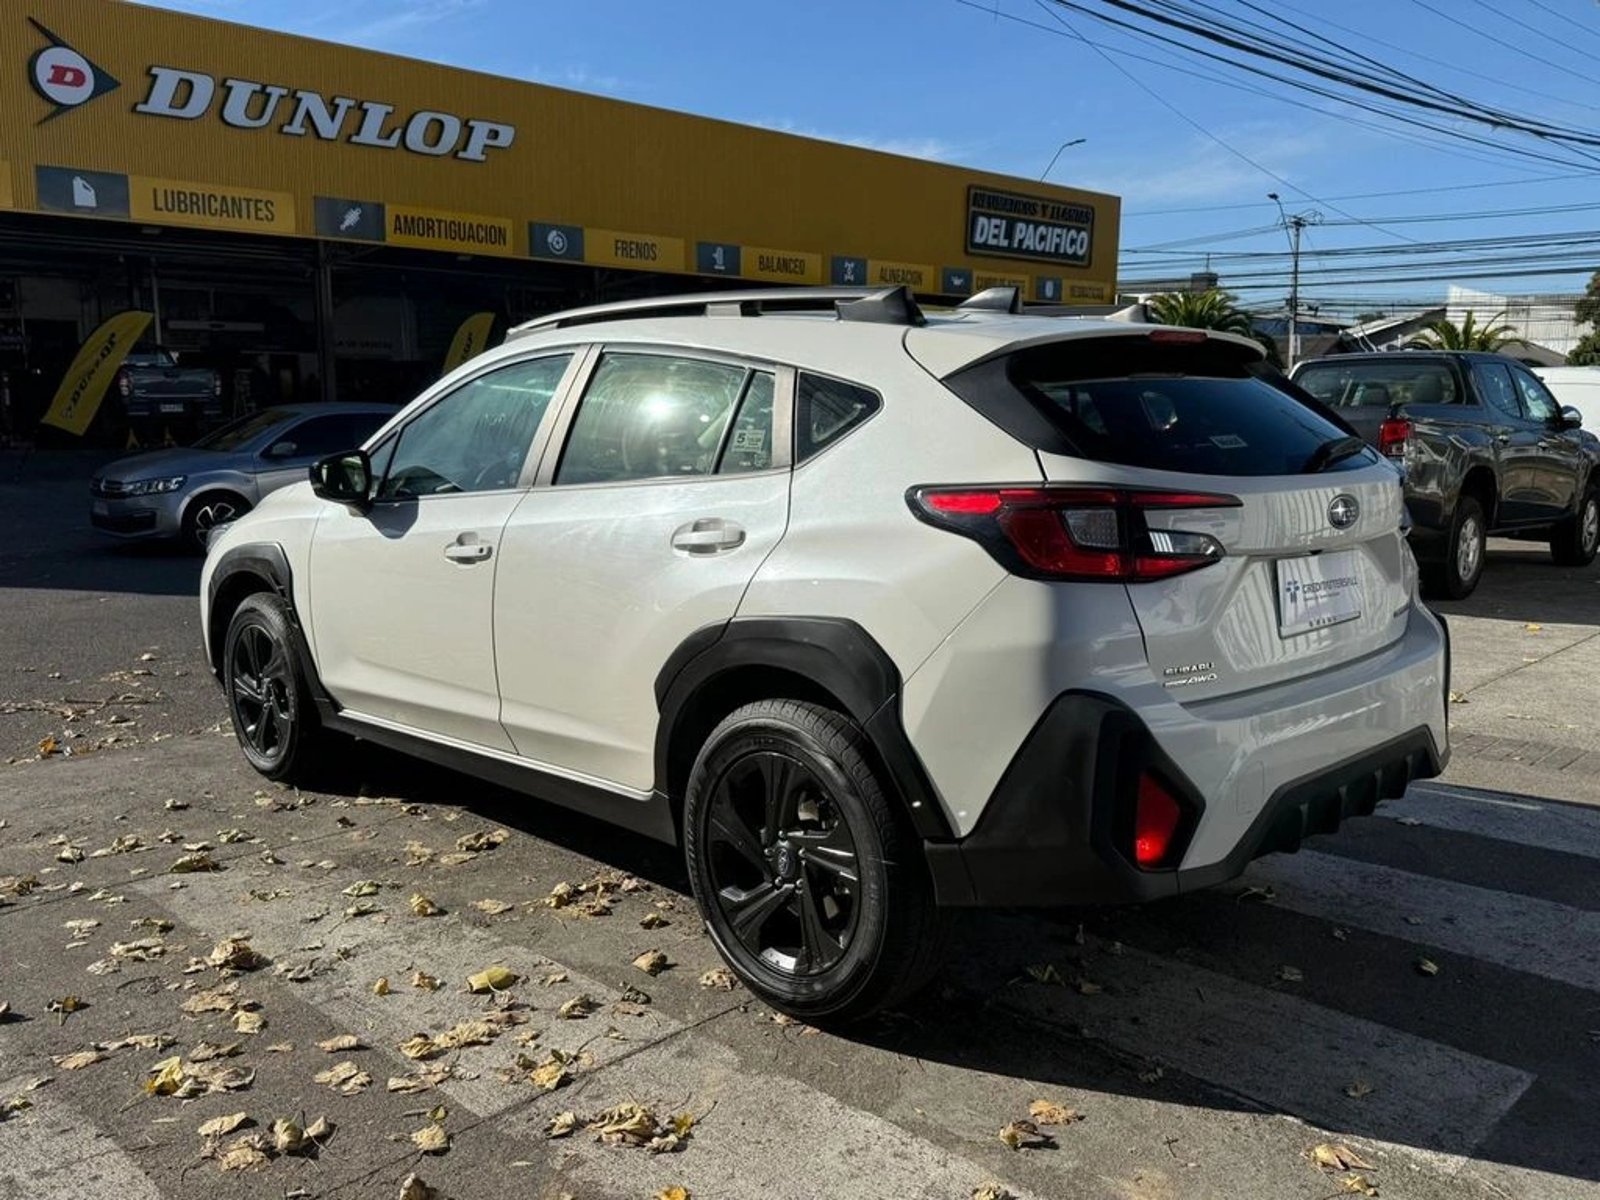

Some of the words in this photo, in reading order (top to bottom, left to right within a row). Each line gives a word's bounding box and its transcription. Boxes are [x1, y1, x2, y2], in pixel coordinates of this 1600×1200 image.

[47, 64, 86, 88] D
[134, 66, 516, 162] DUNLOP
[153, 187, 275, 222] LUBRICANTES
[393, 213, 507, 247] AMORTIGUACION
[973, 216, 1009, 247] DEL
[1013, 222, 1089, 256] PACIFICO
[614, 239, 658, 262] FRENOS
[758, 255, 806, 276] BALANCEO
